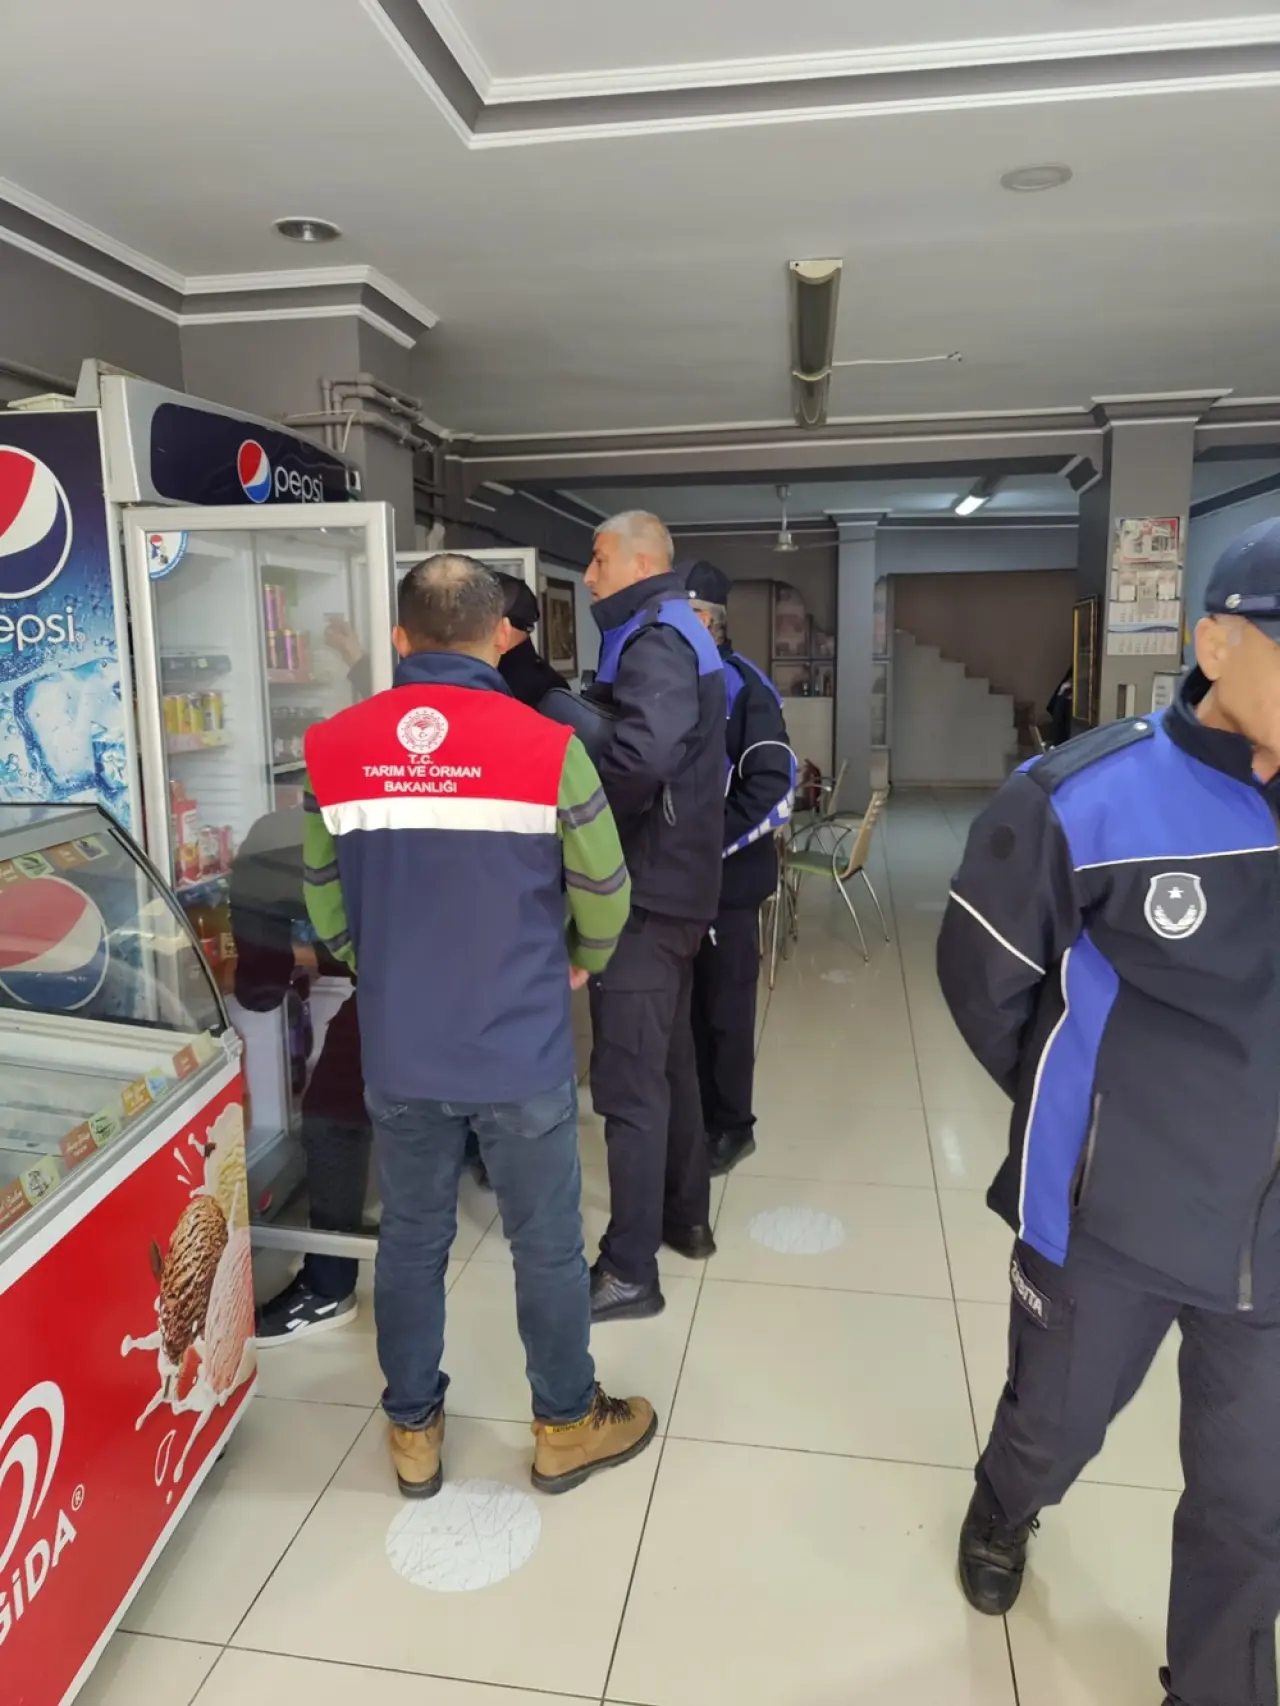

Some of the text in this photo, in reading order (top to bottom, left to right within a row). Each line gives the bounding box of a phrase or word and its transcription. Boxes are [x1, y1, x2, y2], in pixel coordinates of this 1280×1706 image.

[274, 466, 324, 503] pepsi
[408, 754, 434, 765] T.C.
[362, 766, 481, 778] TARIM VE ORMAN
[384, 779, 457, 793] BAKANLIĞI
